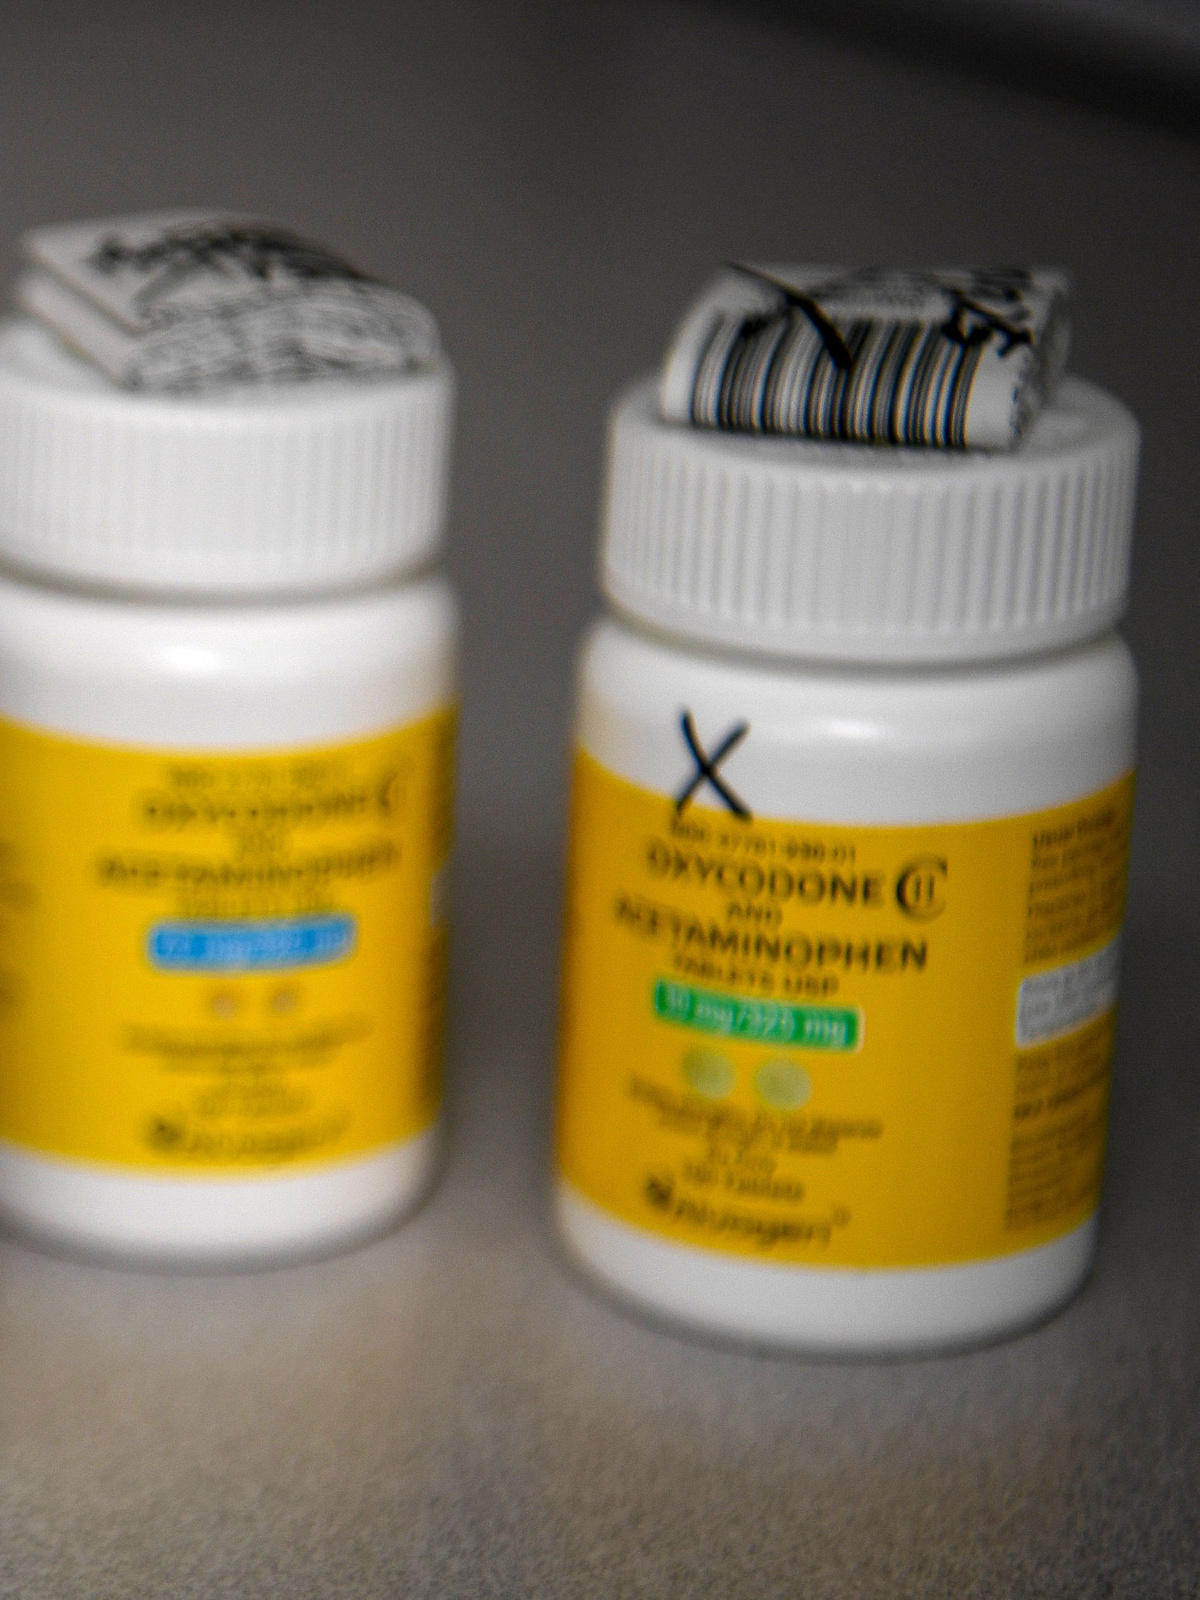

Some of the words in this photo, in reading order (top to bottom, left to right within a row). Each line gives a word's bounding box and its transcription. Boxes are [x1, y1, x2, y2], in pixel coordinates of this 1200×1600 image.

[673, 706, 753, 824] X
[645, 839, 883, 907] OXYCODONE
[615, 894, 929, 973] ACETAMINOPHEN
